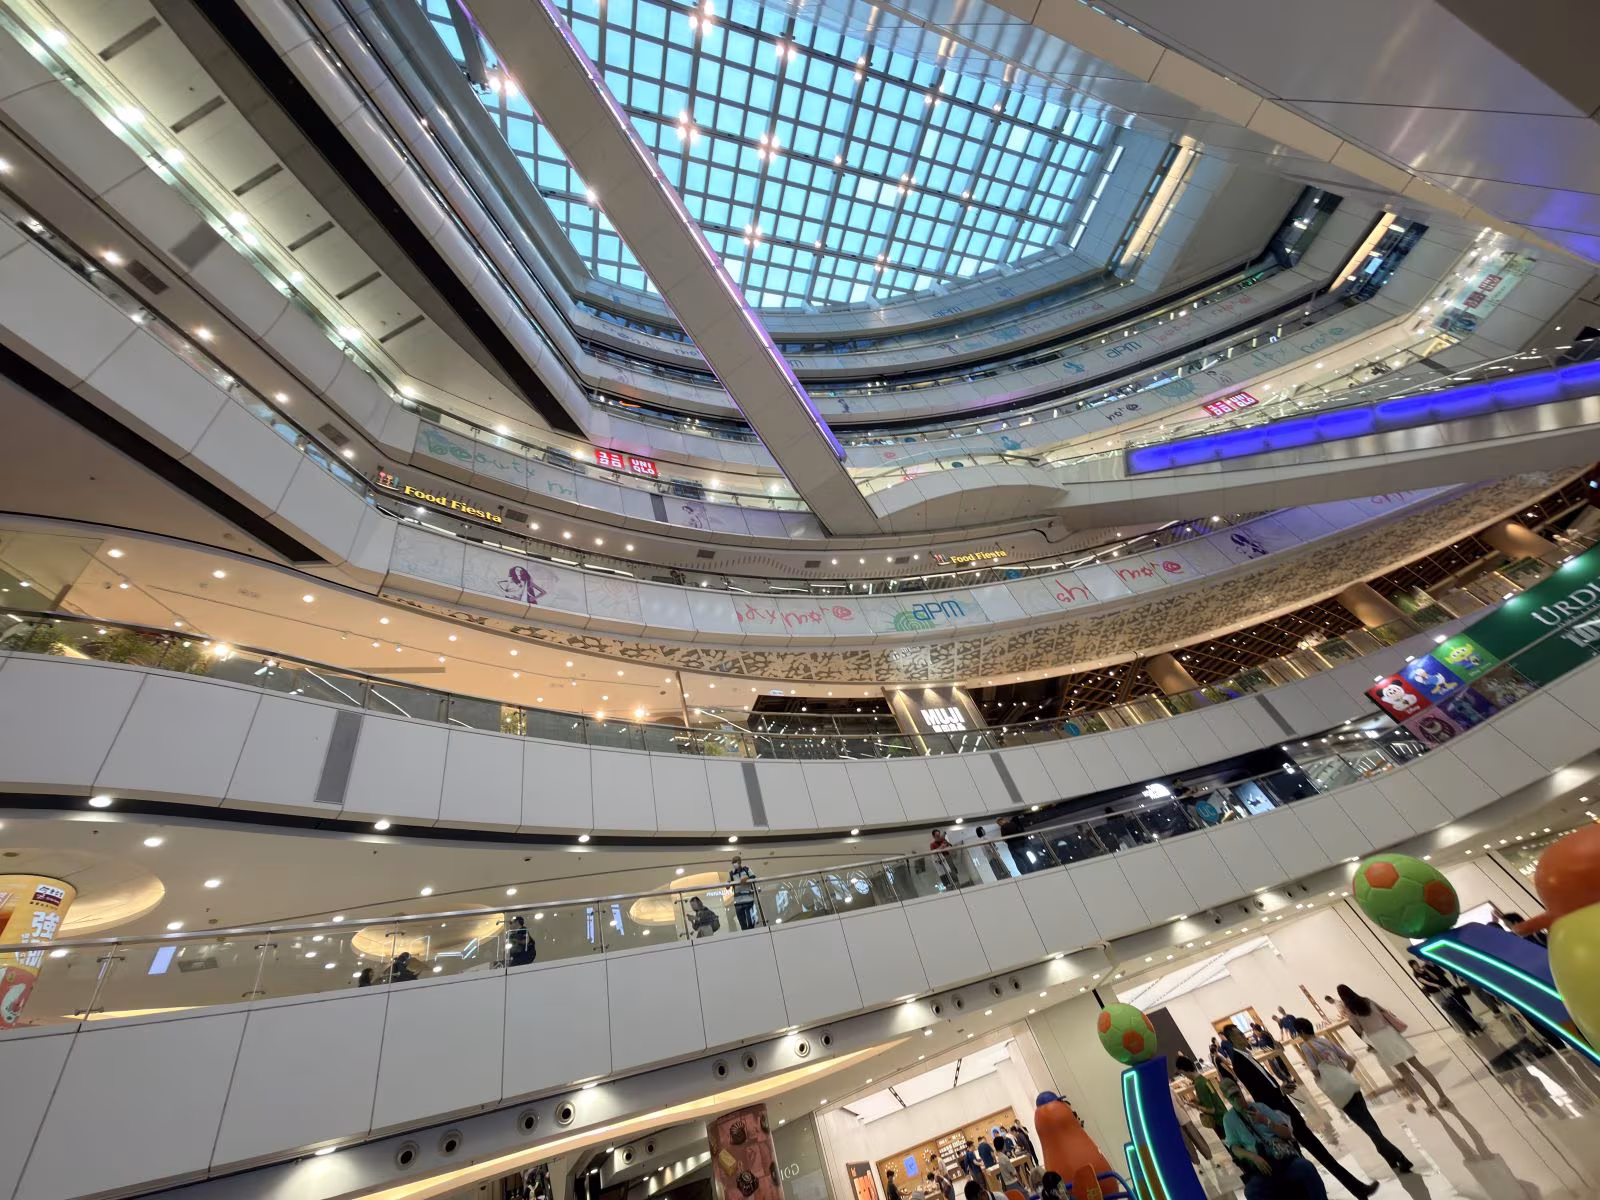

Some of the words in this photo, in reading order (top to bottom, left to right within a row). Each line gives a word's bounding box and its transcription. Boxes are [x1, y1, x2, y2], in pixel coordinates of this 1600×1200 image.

[631, 458, 652, 469] UNI
[633, 465, 655, 475] QLO
[404, 485, 448, 506] Food
[451, 499, 502, 524] Fiesta
[950, 553, 976, 564] Food
[975, 550, 1007, 560] Fiesta
[920, 706, 966, 726] MUJI
